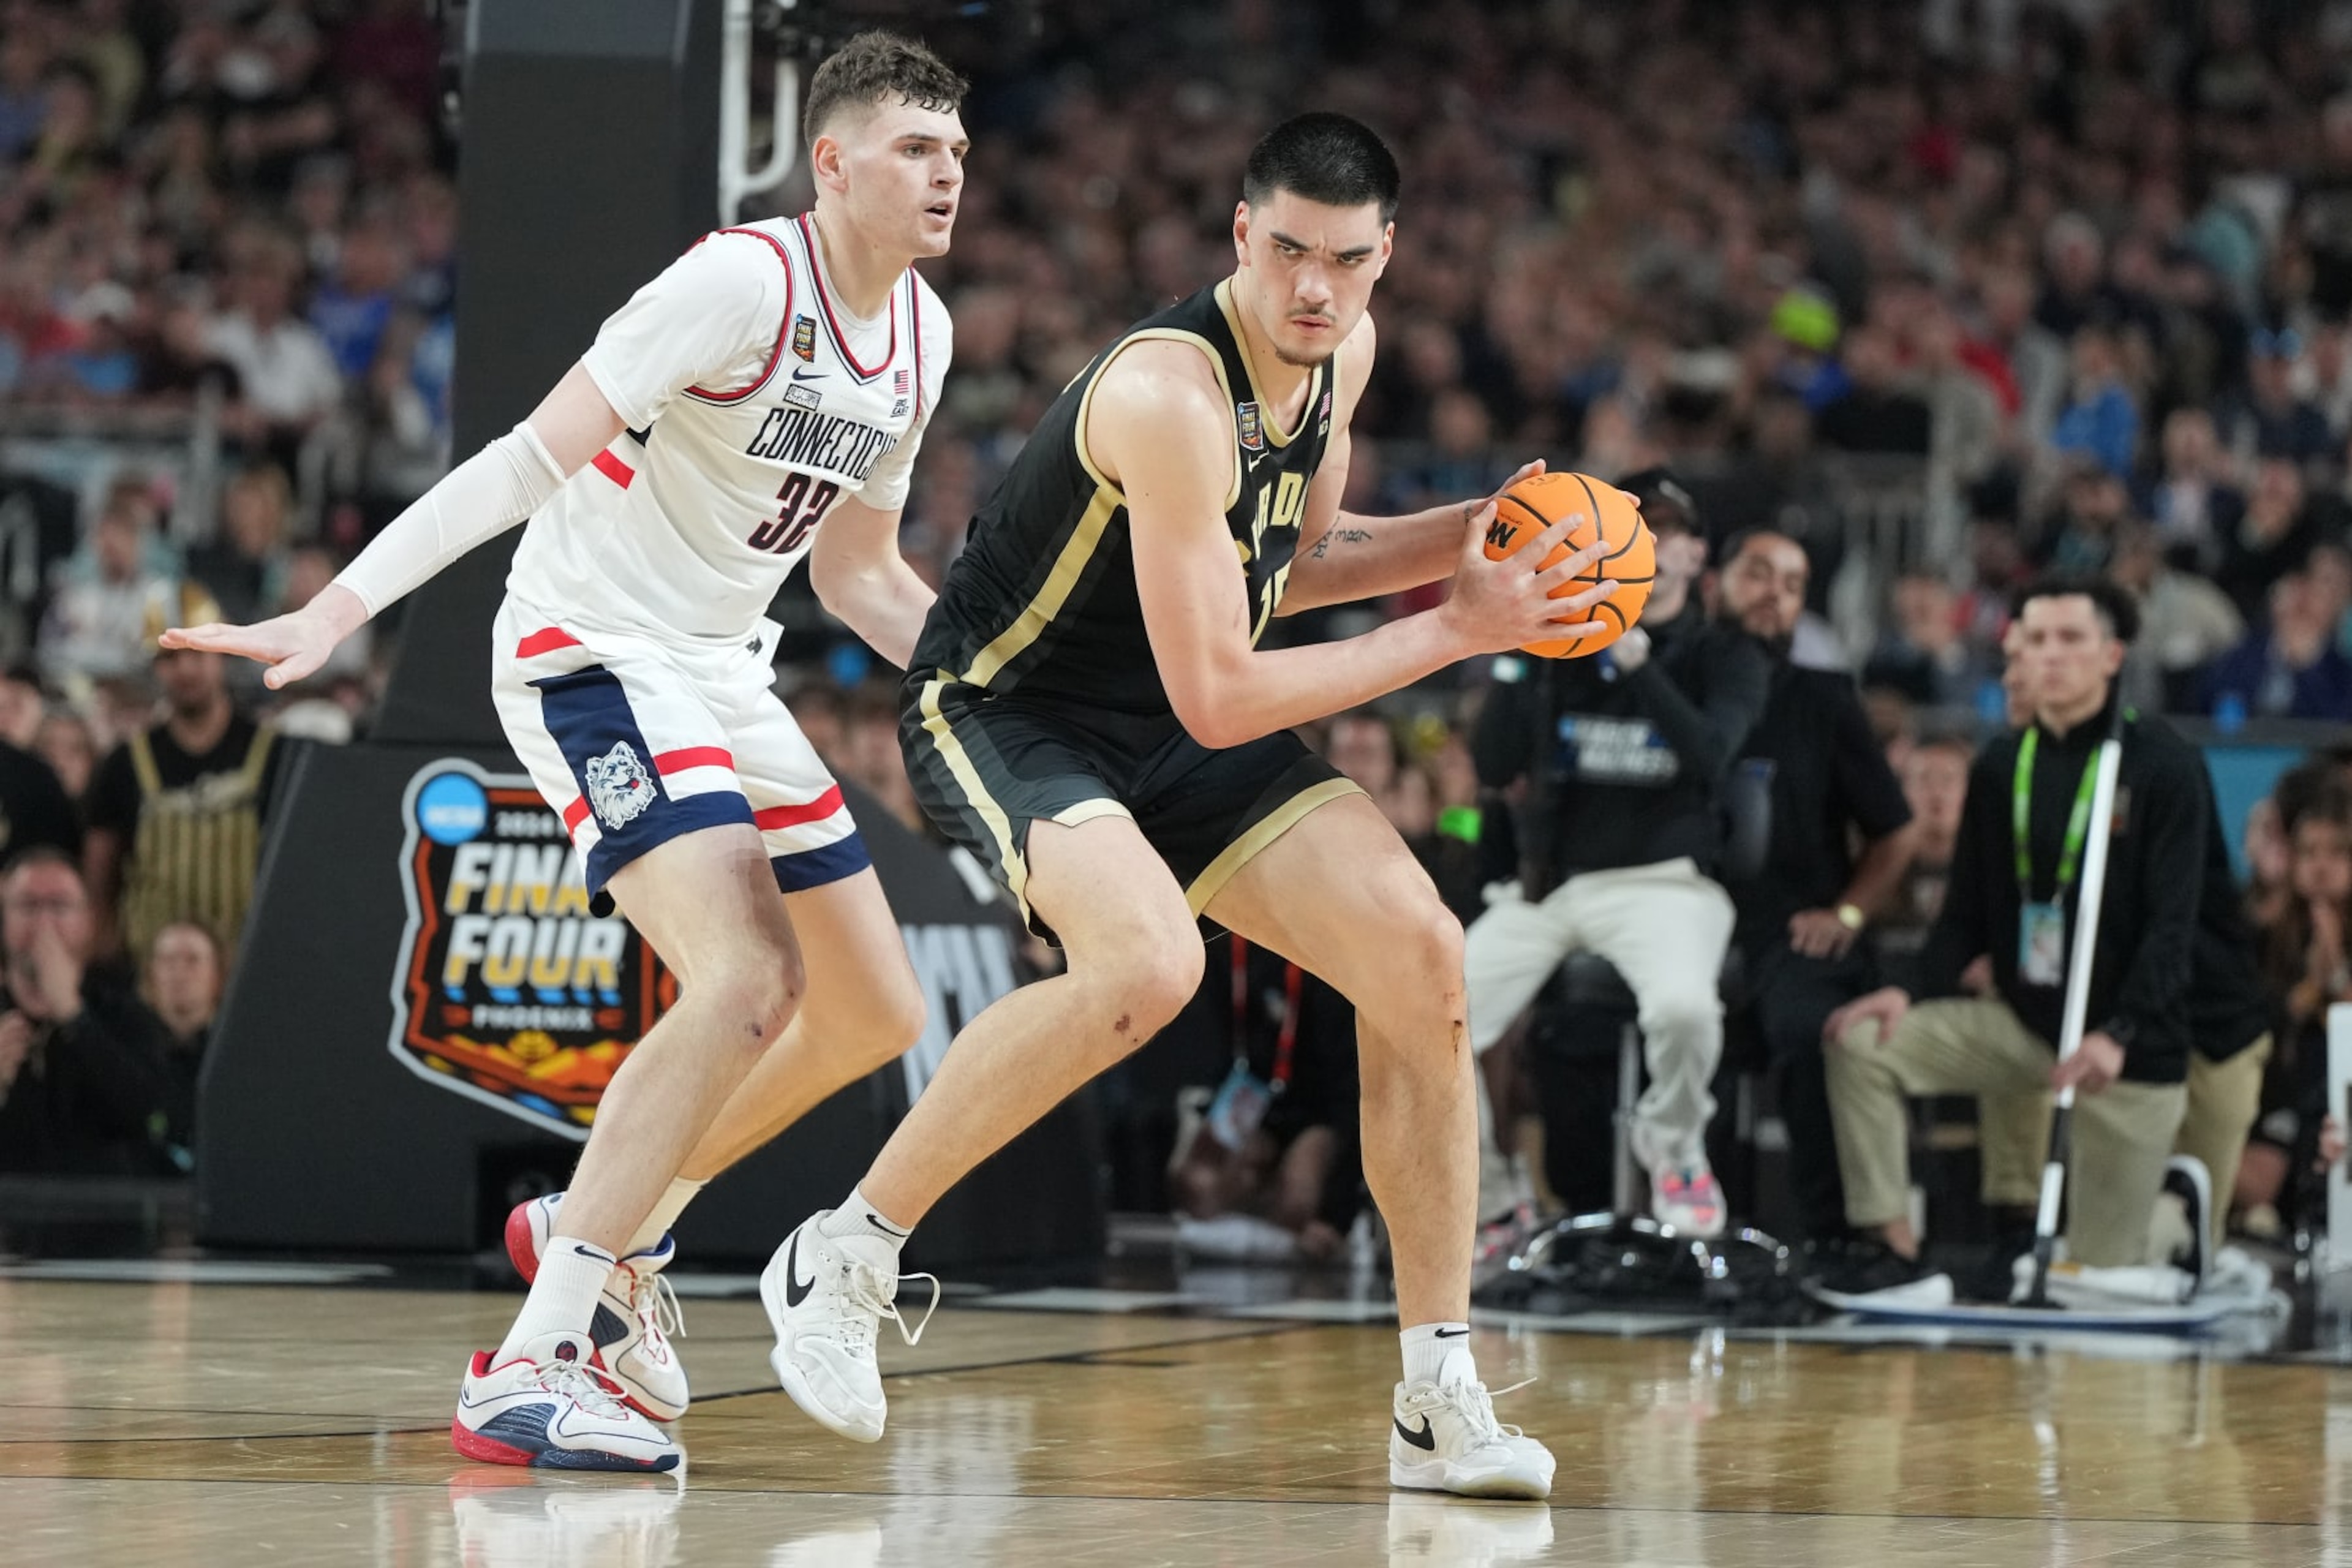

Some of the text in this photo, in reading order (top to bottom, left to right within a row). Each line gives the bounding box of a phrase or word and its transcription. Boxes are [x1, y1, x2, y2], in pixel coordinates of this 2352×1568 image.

[747, 471, 839, 554] 32
[444, 842, 624, 916] FINA
[442, 914, 627, 991] FOUR
[472, 1004, 594, 1030] PHOENIX
